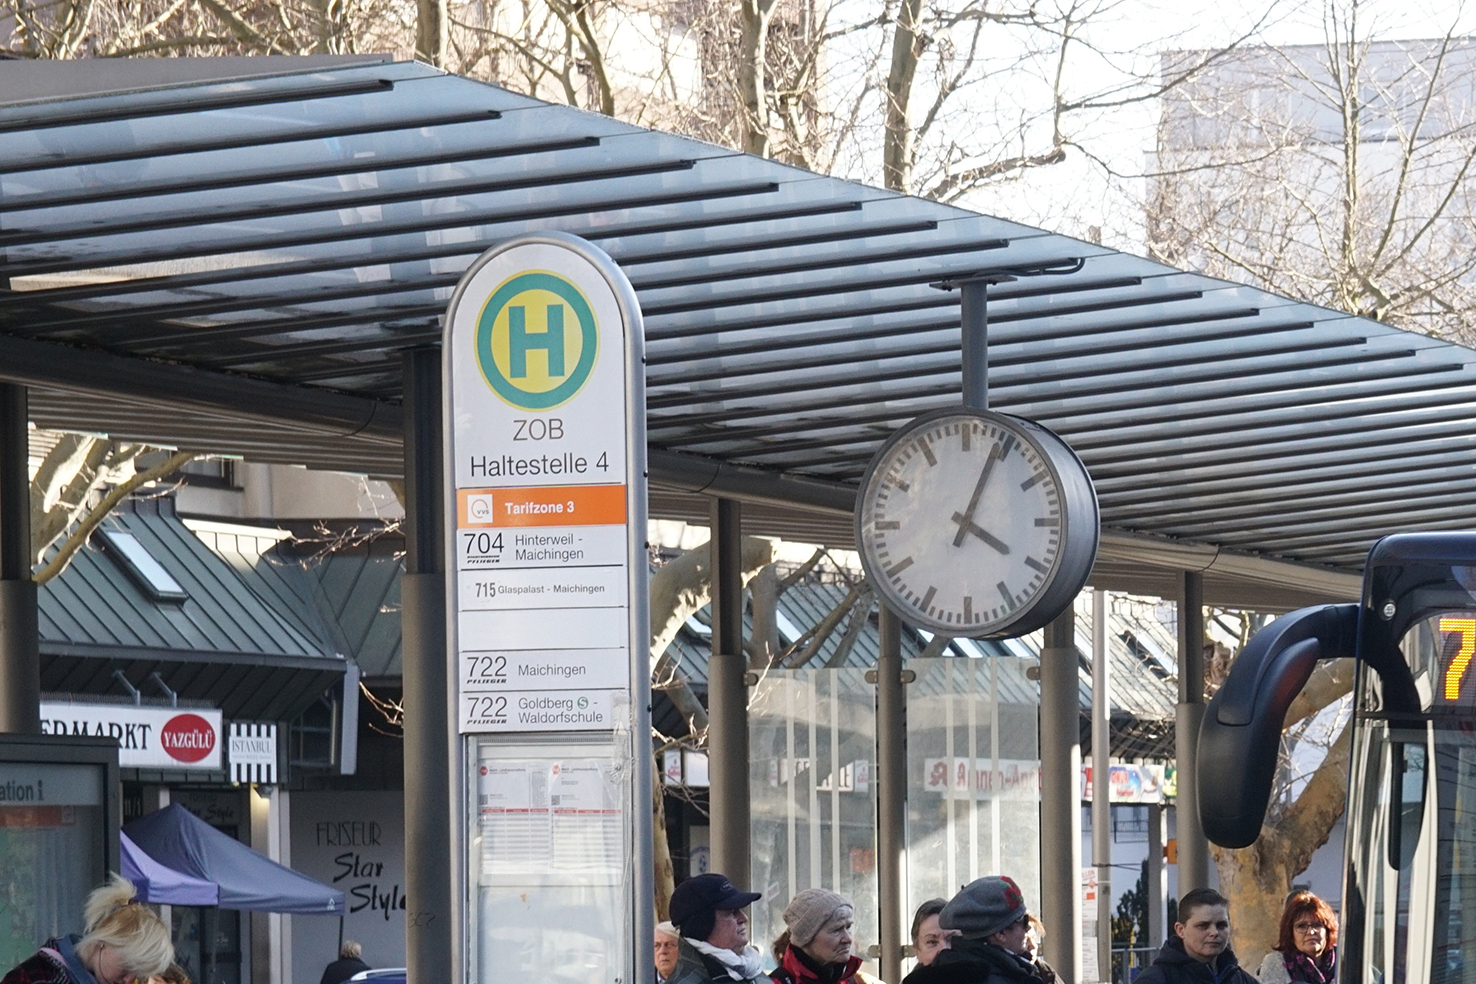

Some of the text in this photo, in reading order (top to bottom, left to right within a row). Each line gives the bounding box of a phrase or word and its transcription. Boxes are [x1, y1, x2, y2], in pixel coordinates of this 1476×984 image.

[508, 303, 565, 379] H
[512, 418, 564, 441] ZOB
[471, 451, 609, 477] Haltestelle 4
[504, 501, 575, 515] Tarifzone 3
[463, 532, 505, 554] 704
[515, 533, 574, 546] Hinterweil
[515, 548, 584, 562] Maichingen
[475, 582, 496, 598] 715
[498, 585, 544, 595] Glaspalast
[553, 584, 605, 594] Maichingen
[466, 656, 507, 677] 722
[518, 664, 586, 678] Maichingen
[467, 696, 507, 717] 722
[518, 697, 573, 711] Goldberg
[518, 711, 603, 723] Waldorfschule
[163, 729, 213, 750] YAZGÜLÜ
[316, 821, 382, 846] FRISEUR
[332, 852, 384, 883] Star
